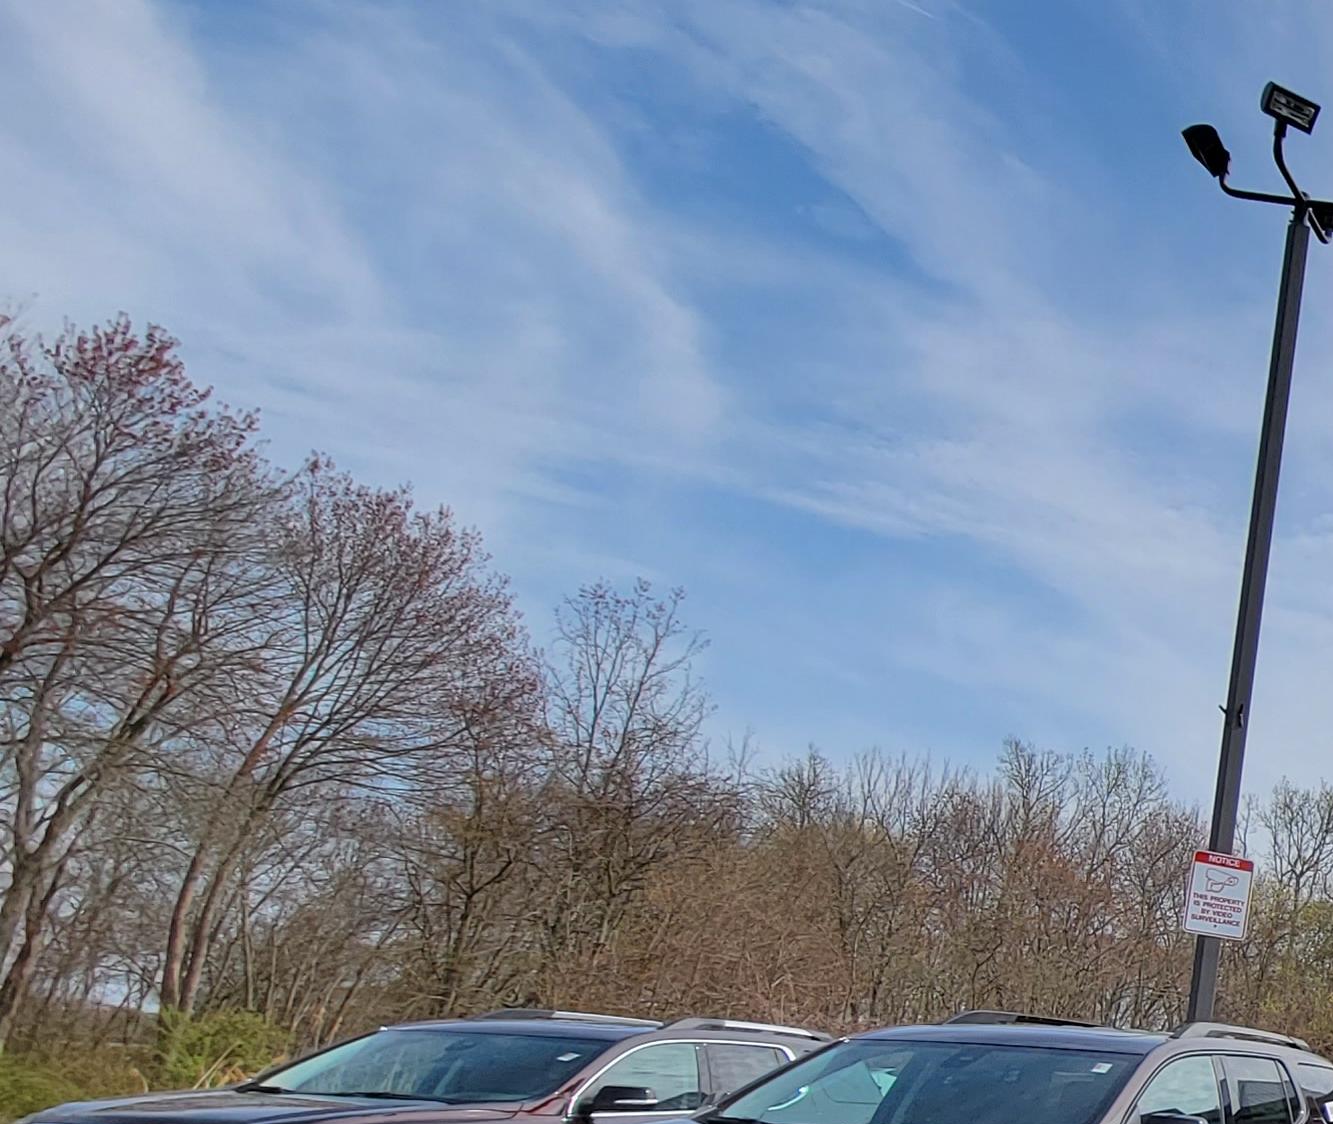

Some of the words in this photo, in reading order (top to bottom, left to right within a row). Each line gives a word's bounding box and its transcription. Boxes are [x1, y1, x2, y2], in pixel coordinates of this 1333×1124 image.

[1208, 855, 1241, 868] NOTICE
[1193, 892, 1208, 900] THIS
[1210, 895, 1245, 907] PROPERTY
[1202, 901, 1242, 913] PROTECTED
[1191, 913, 1240, 927] SURVEILLANCE
[1213, 910, 1233, 919] VIDEO
